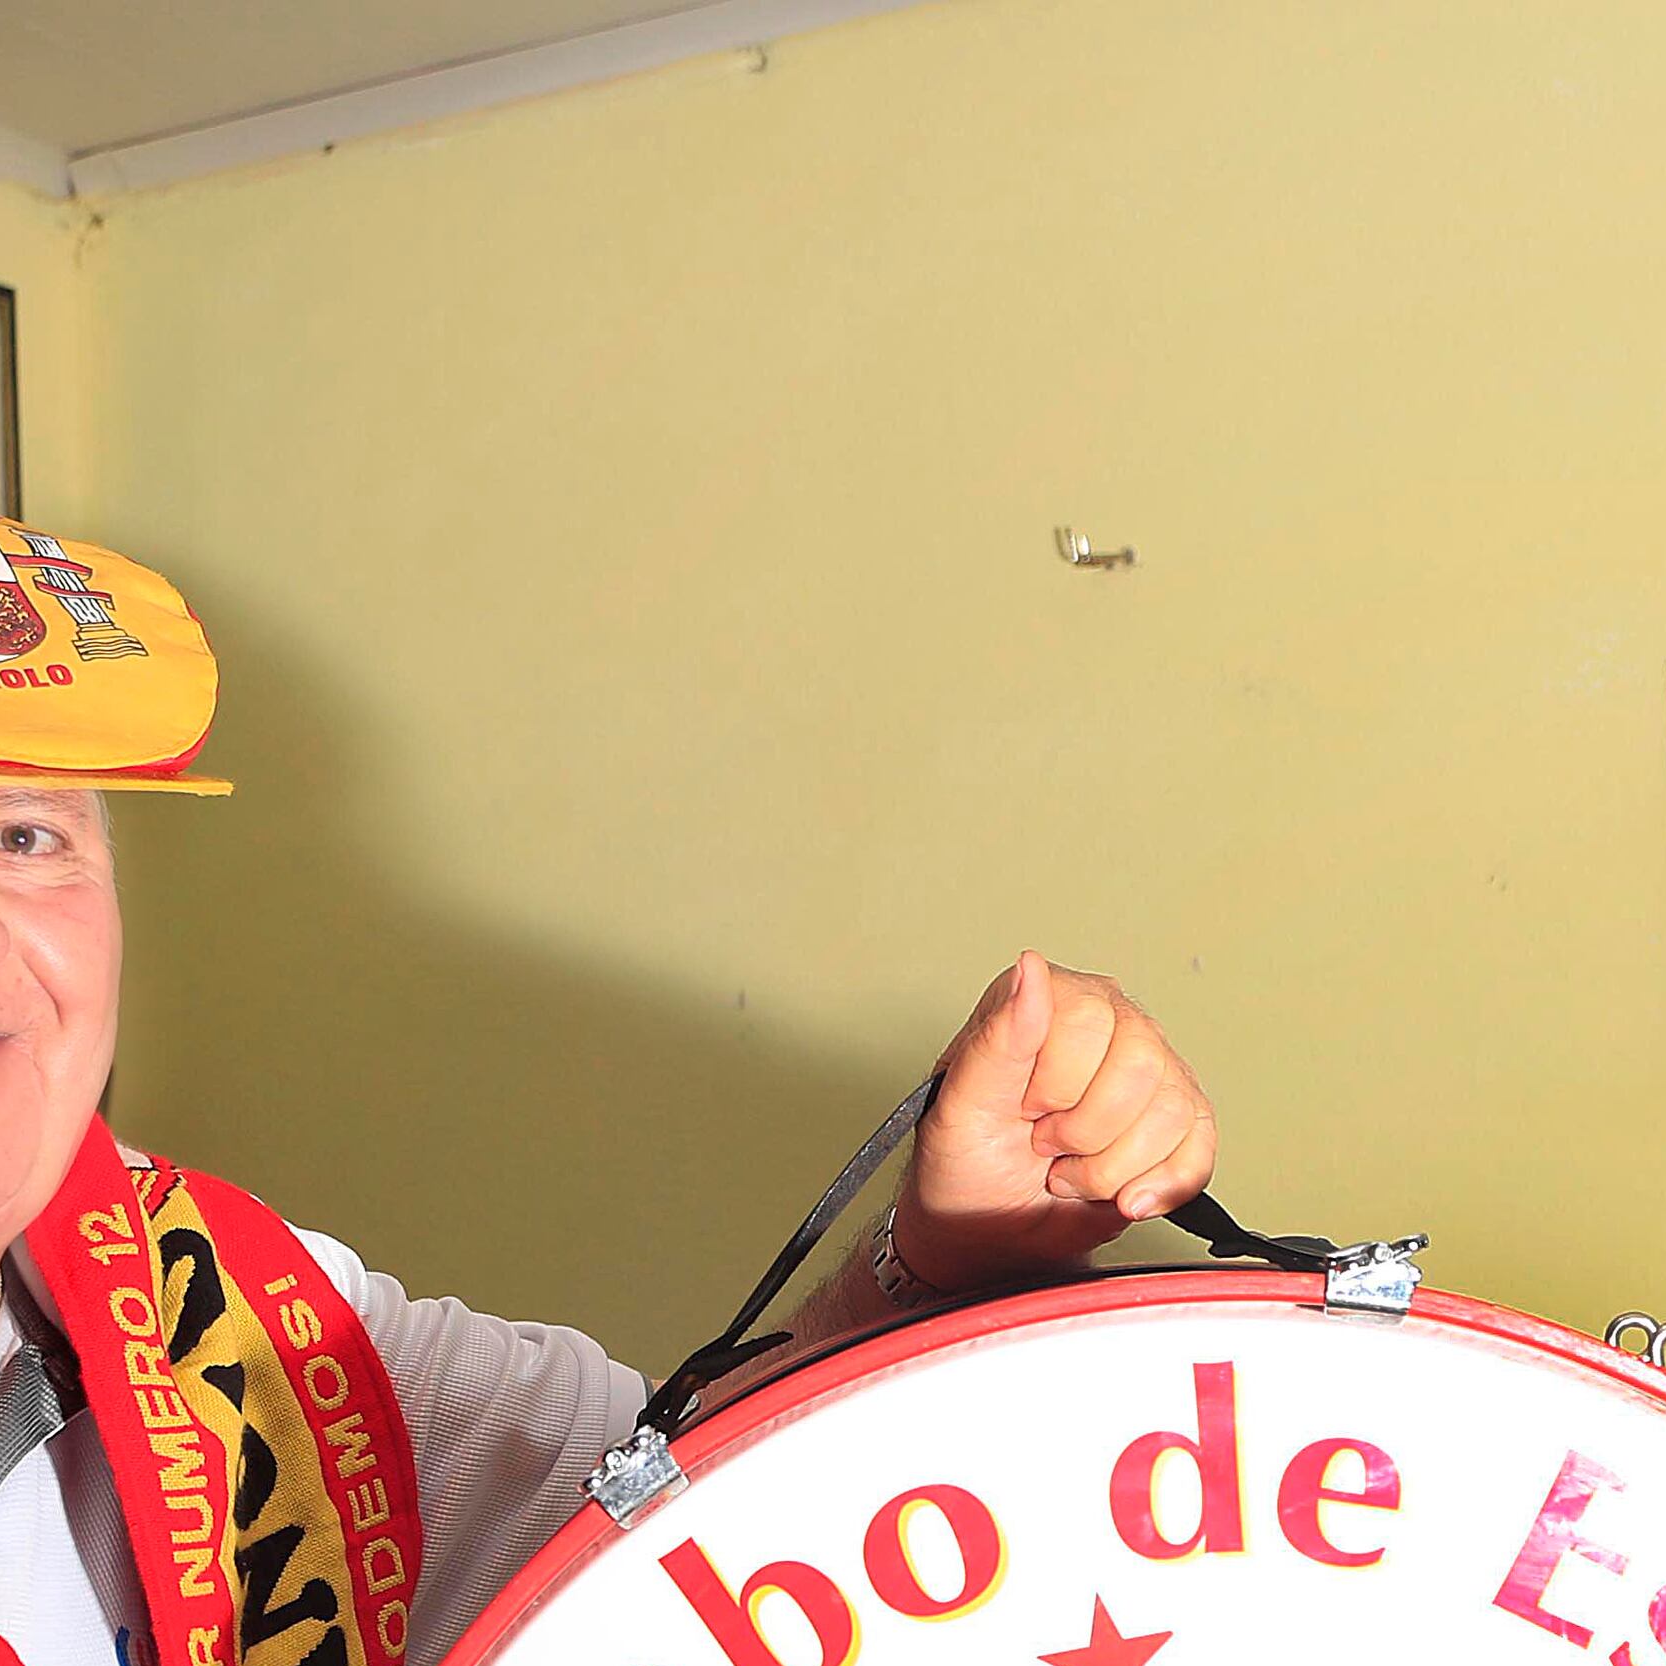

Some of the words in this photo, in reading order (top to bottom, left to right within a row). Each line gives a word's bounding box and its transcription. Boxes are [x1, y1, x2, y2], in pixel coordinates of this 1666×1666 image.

[82, 1201, 140, 1267] 12
[108, 1286, 217, 1597] NUMERO
[1109, 1361, 1406, 1570] de
